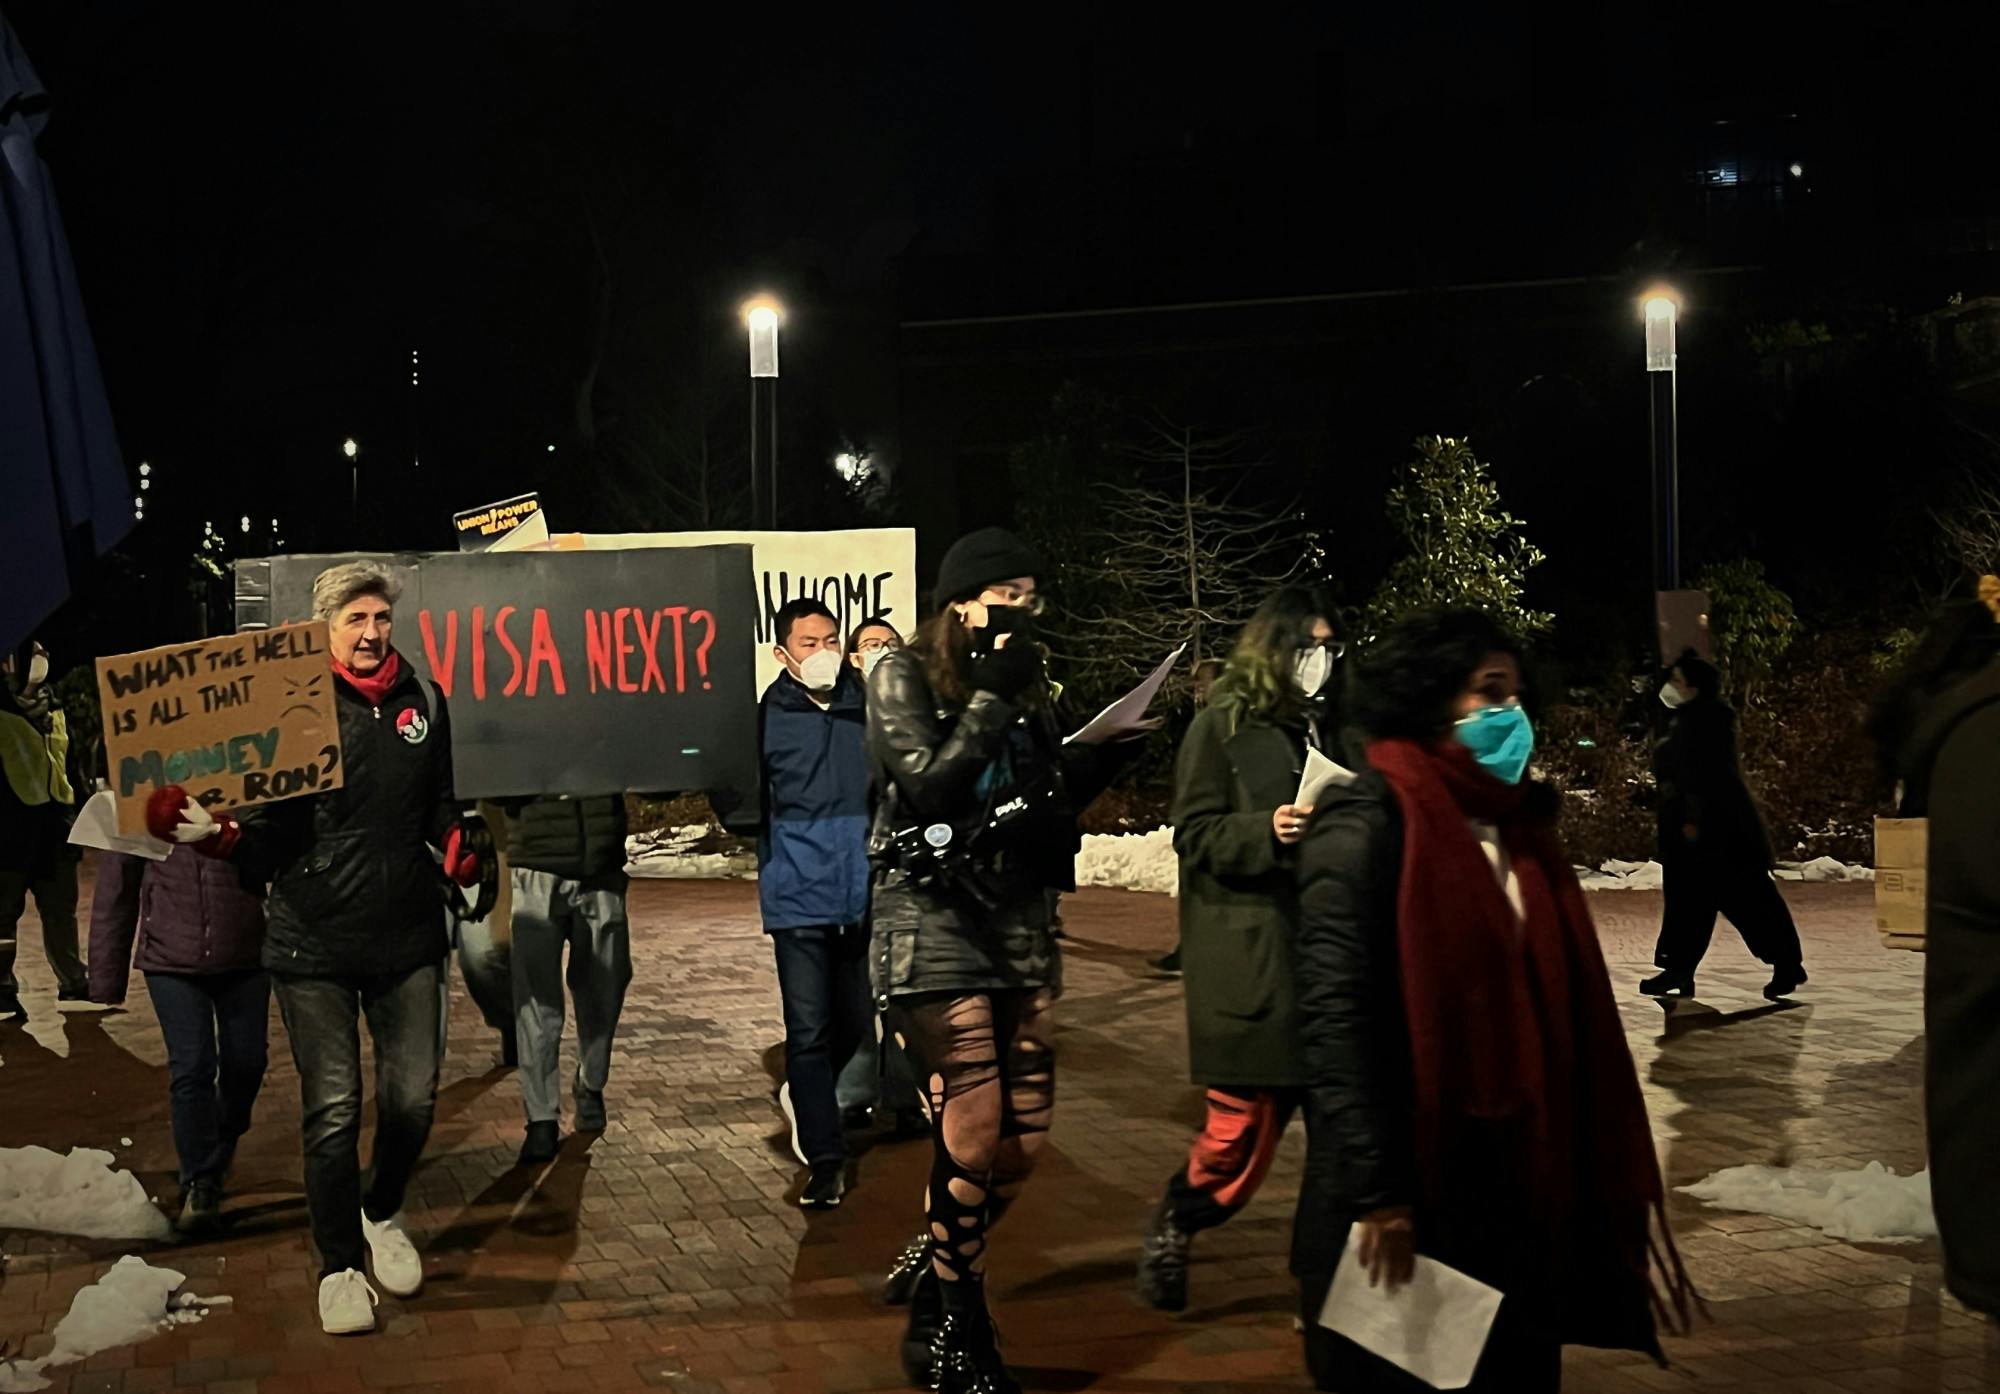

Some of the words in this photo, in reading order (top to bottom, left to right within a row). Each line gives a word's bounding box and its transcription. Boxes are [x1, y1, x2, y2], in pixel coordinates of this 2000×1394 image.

[497, 500, 537, 518] POWER
[107, 647, 204, 698] WHAT
[205, 648, 247, 672] THE
[254, 631, 323, 663] HELL
[419, 606, 566, 699] VISA
[585, 608, 716, 694] NEXT?
[112, 708, 137, 736] IS
[149, 698, 189, 726] ALL
[198, 674, 254, 713] THAT
[119, 727, 280, 797] MONEY
[243, 744, 339, 801] RON?
